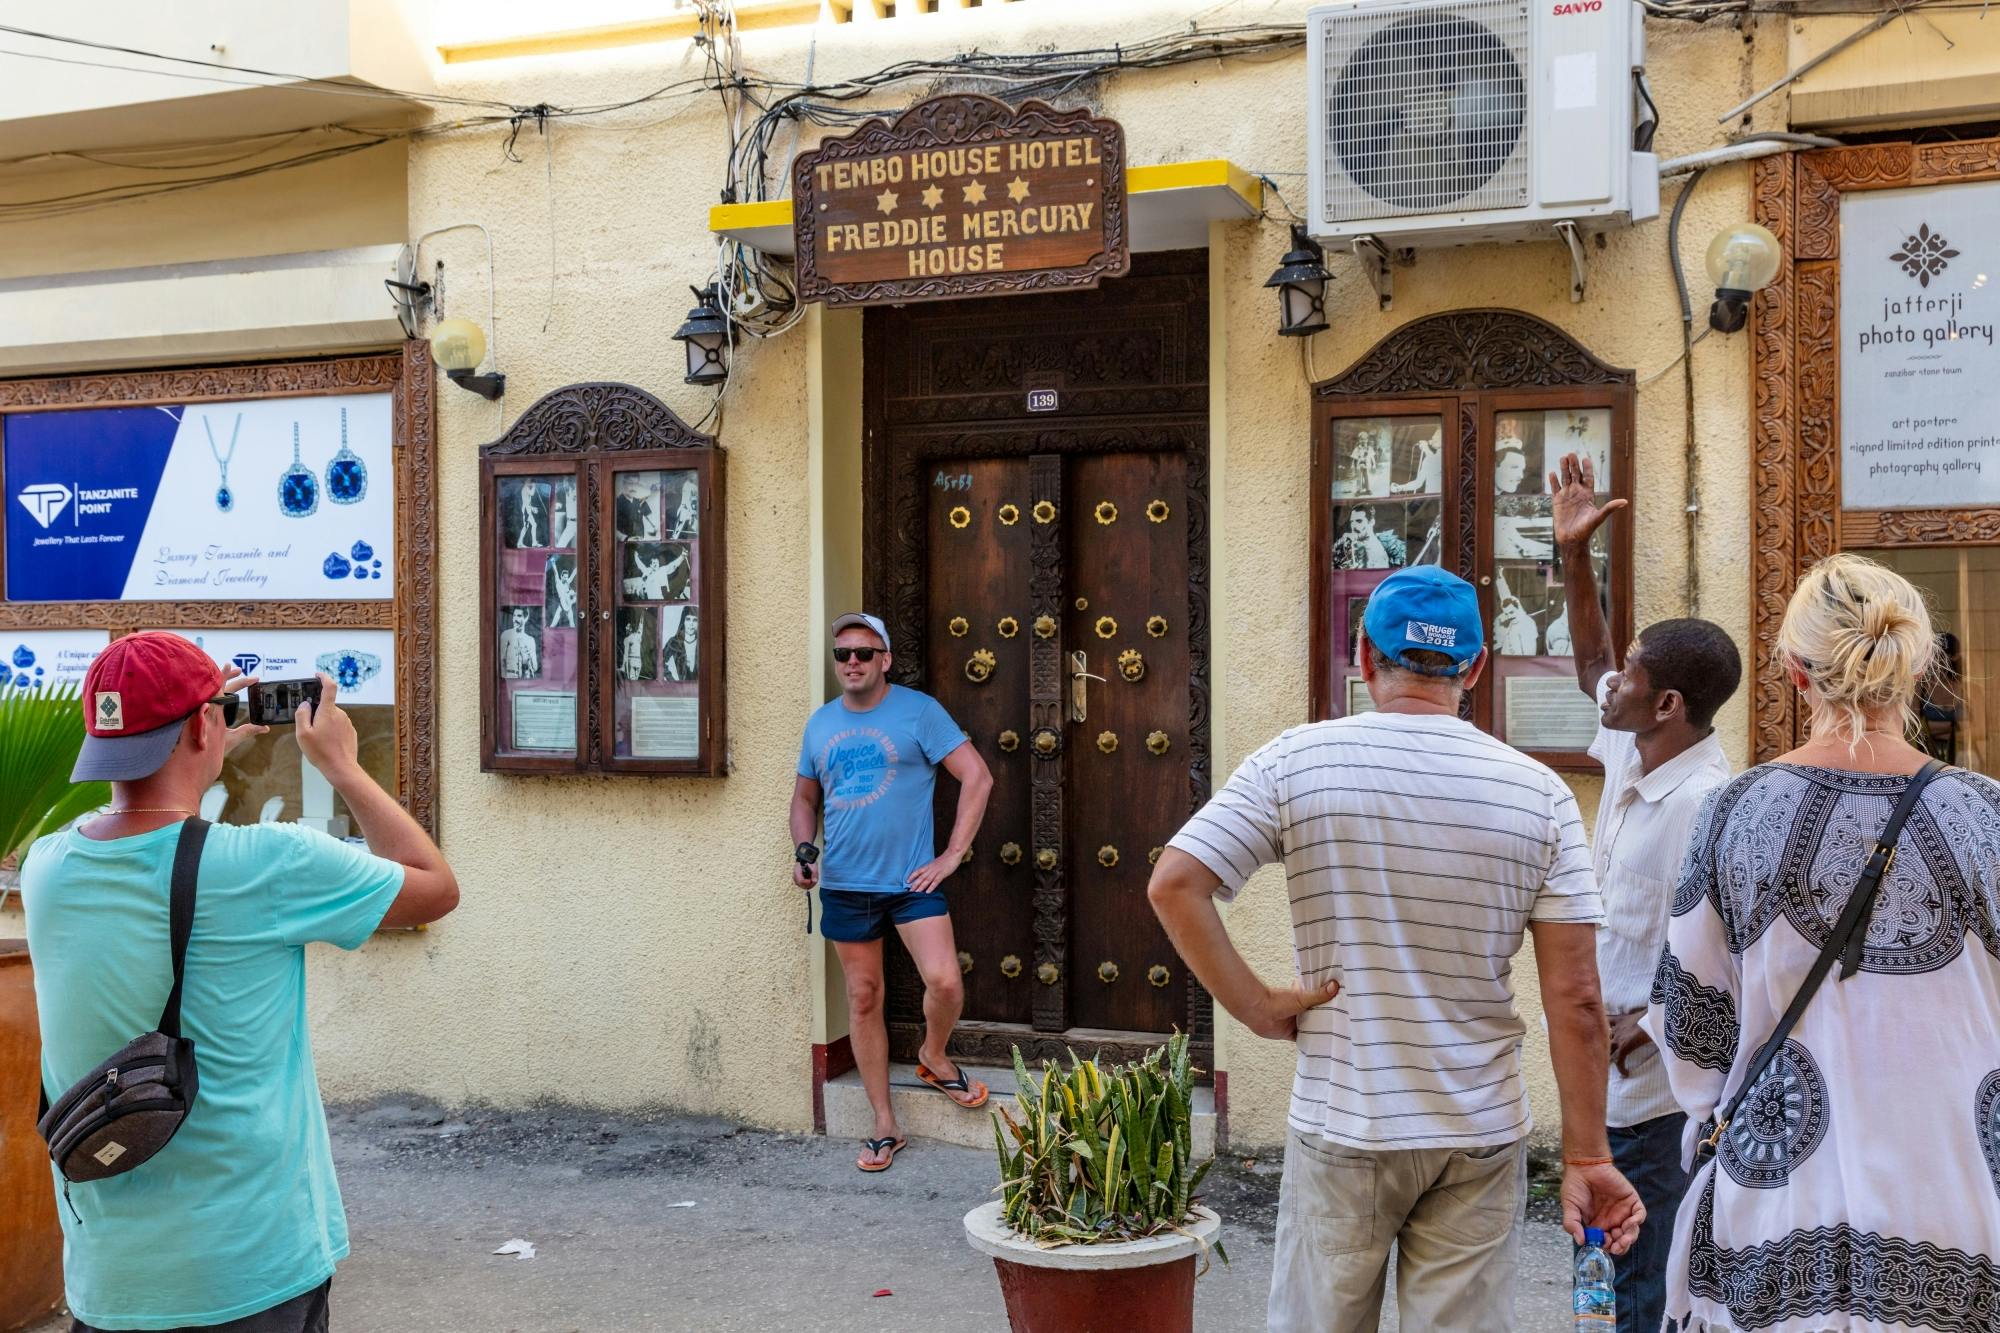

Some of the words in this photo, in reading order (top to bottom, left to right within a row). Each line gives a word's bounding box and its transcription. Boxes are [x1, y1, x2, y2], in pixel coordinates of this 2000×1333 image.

[1552, 1, 1602, 16] SANYO
[816, 155, 903, 192] TEMBO
[911, 146, 1001, 180] HOUSE
[1009, 137, 1101, 171] HOTEL
[827, 215, 947, 252] FREDDIE
[963, 202, 1094, 240] MERCURY
[909, 243, 1004, 277] HOUSE
[1884, 292, 1963, 322] jafferji
[1859, 324, 1915, 353] photo
[1923, 319, 1993, 349] gallery
[1884, 369, 1916, 378] zanzibar
[1942, 367, 1963, 375] town
[1032, 394, 1055, 407] 139
[1892, 417, 1910, 429] art
[1913, 416, 1958, 432] posters
[1850, 440, 1884, 456] signed
[1887, 438, 1924, 452] limited
[1927, 437, 1964, 450] edition
[1869, 460, 1939, 478] photography
[1942, 458, 1981, 475] gallery
[79, 488, 138, 500] TANZANITE
[79, 503, 112, 514] POINT
[33, 537, 63, 547] Jewellery
[64, 536, 80, 544] That
[80, 535, 98, 543] Lasts
[99, 534, 125, 543] Forever
[153, 546, 198, 566] Luxury
[204, 544, 262, 560] Tanzanite
[267, 543, 291, 558] and
[155, 570, 208, 586] Diamond
[213, 568, 268, 588] Jewellery
[1429, 624, 1457, 635] RUGBY
[1426, 637, 1456, 647] 2015
[265, 657, 298, 665] TANZANITE
[828, 743, 876, 771] Venice
[842, 752, 885, 780] Beach
